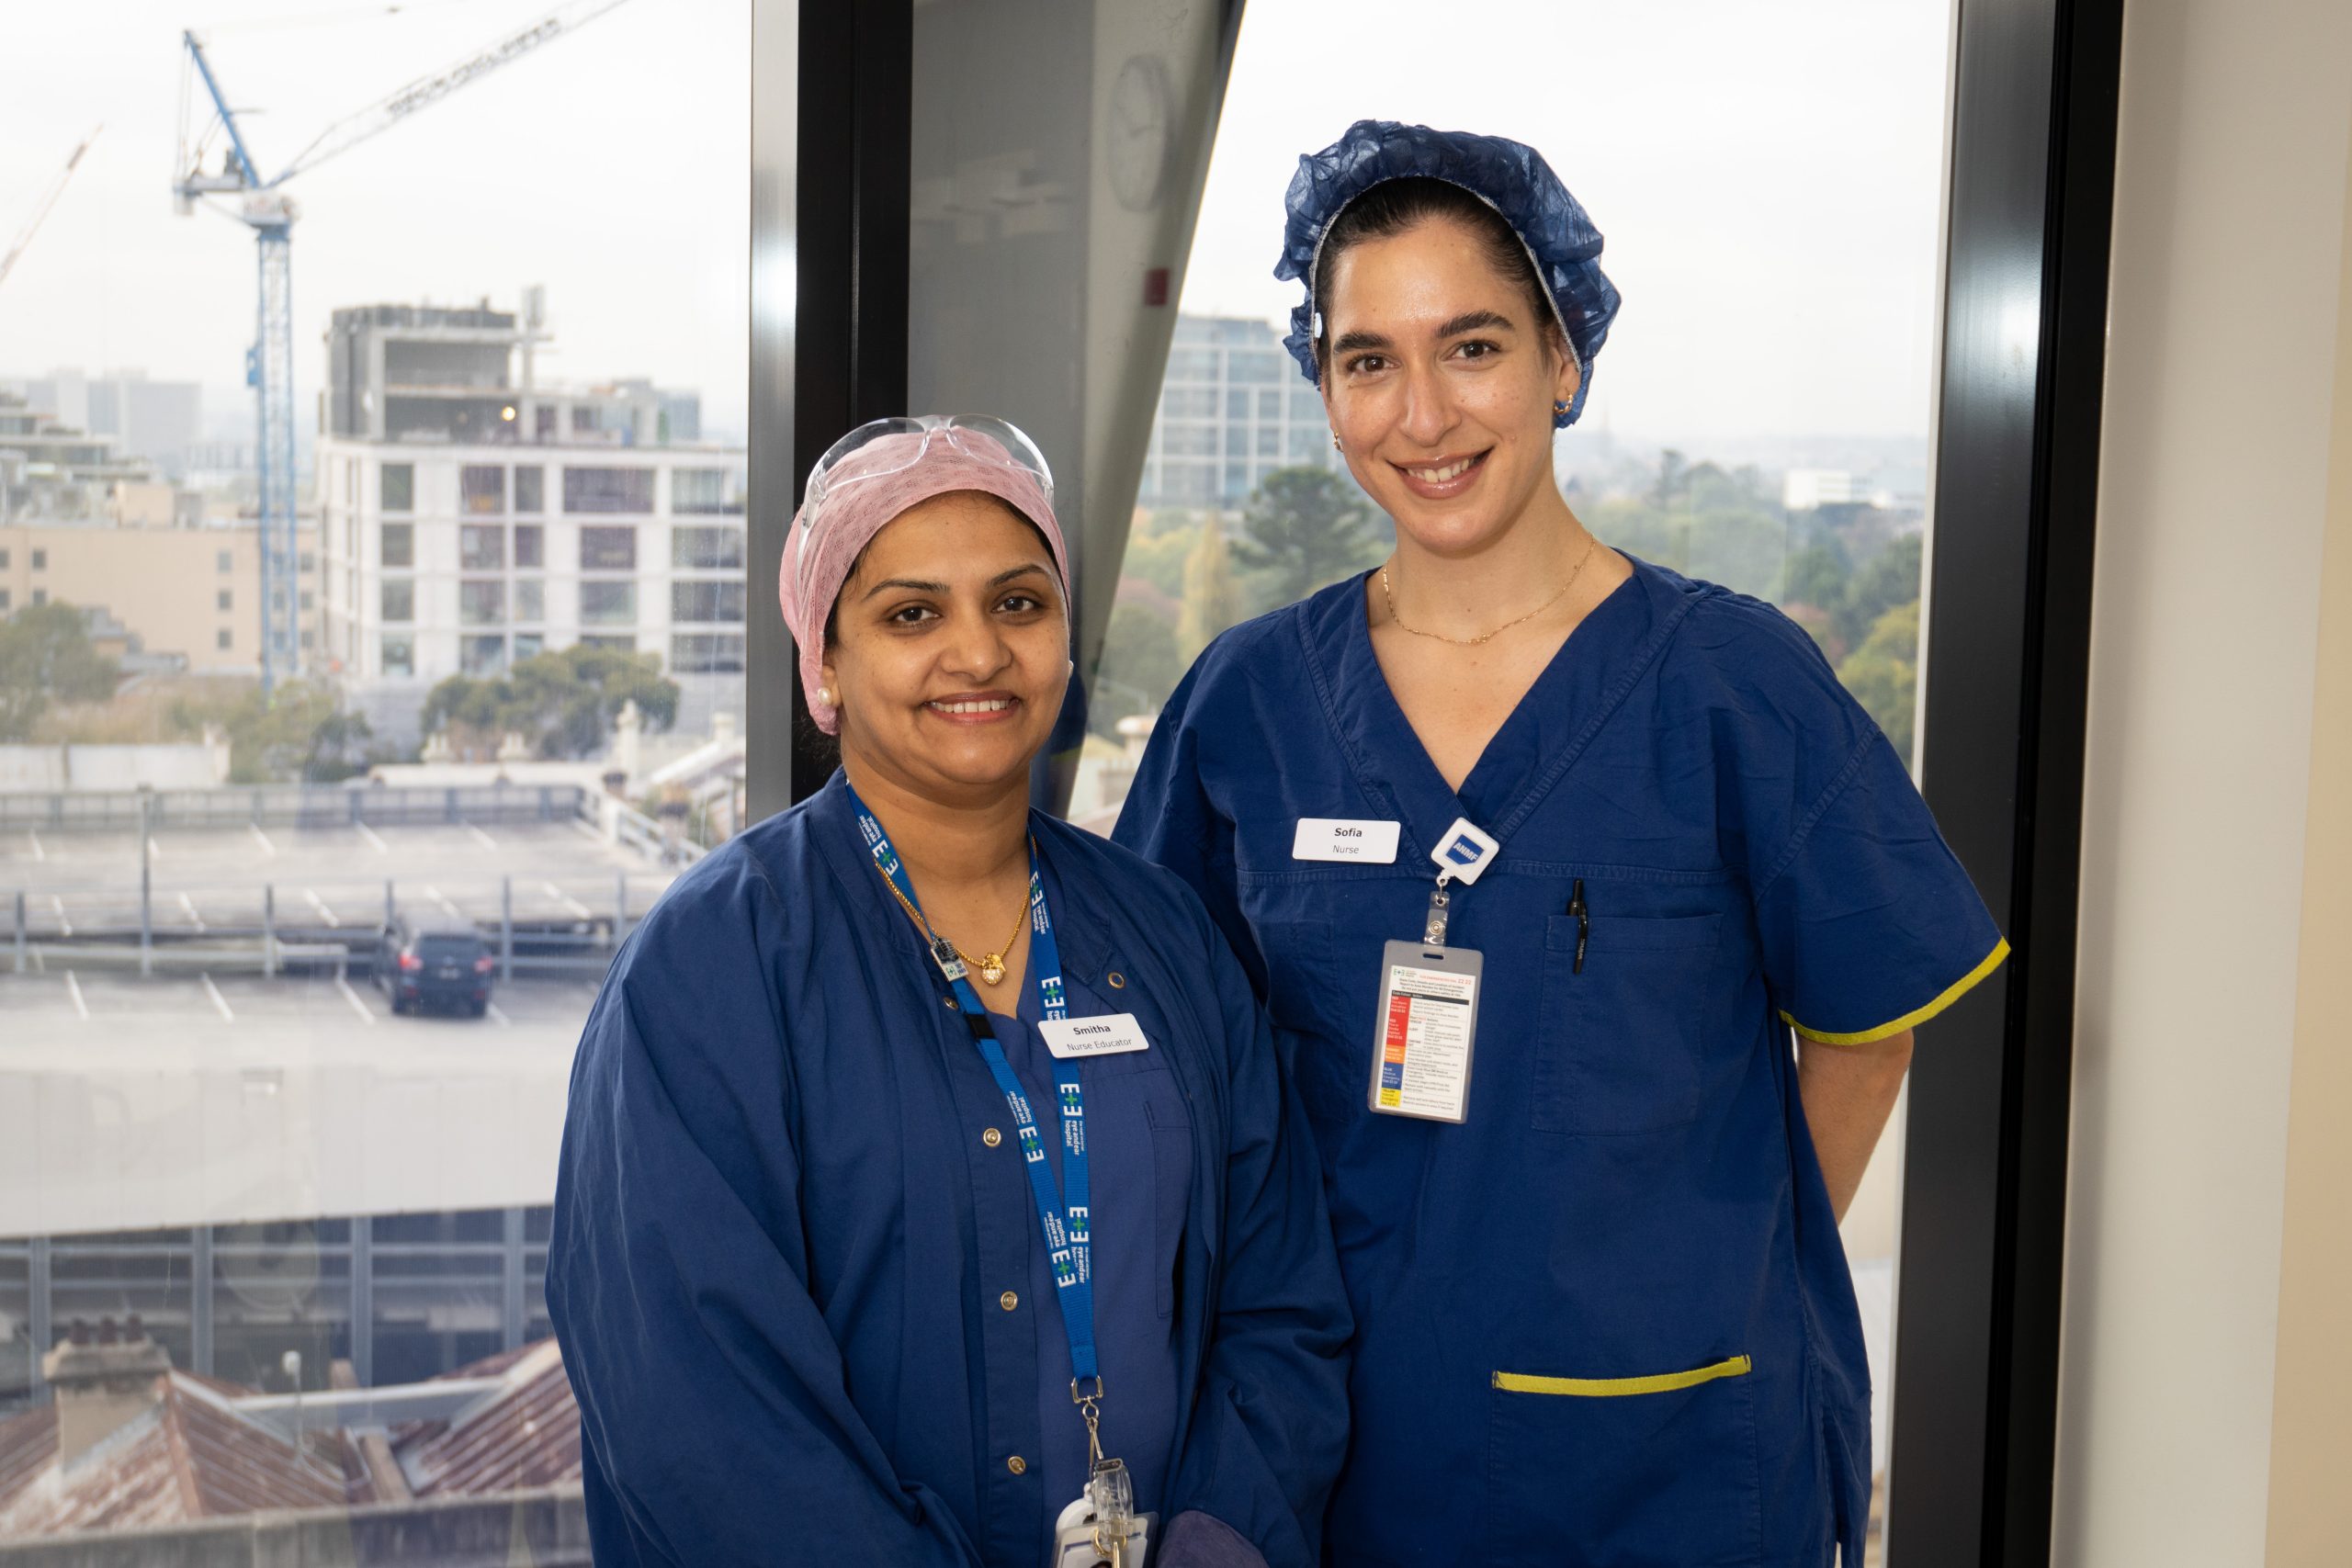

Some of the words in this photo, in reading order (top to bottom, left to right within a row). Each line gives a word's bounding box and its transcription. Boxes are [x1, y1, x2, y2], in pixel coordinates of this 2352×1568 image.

[1334, 828, 1363, 838] Sofia
[1332, 845, 1360, 854] Nurse
[1453, 841, 1478, 862] ANMF
[1073, 1024, 1112, 1035] Smitha
[1067, 1043, 1092, 1052] Nurse
[1095, 1038, 1133, 1049] Educator
[1012, 1100, 1022, 1113] and
[1065, 1121, 1073, 1146] hospital
[1049, 1222, 1057, 1235] and
